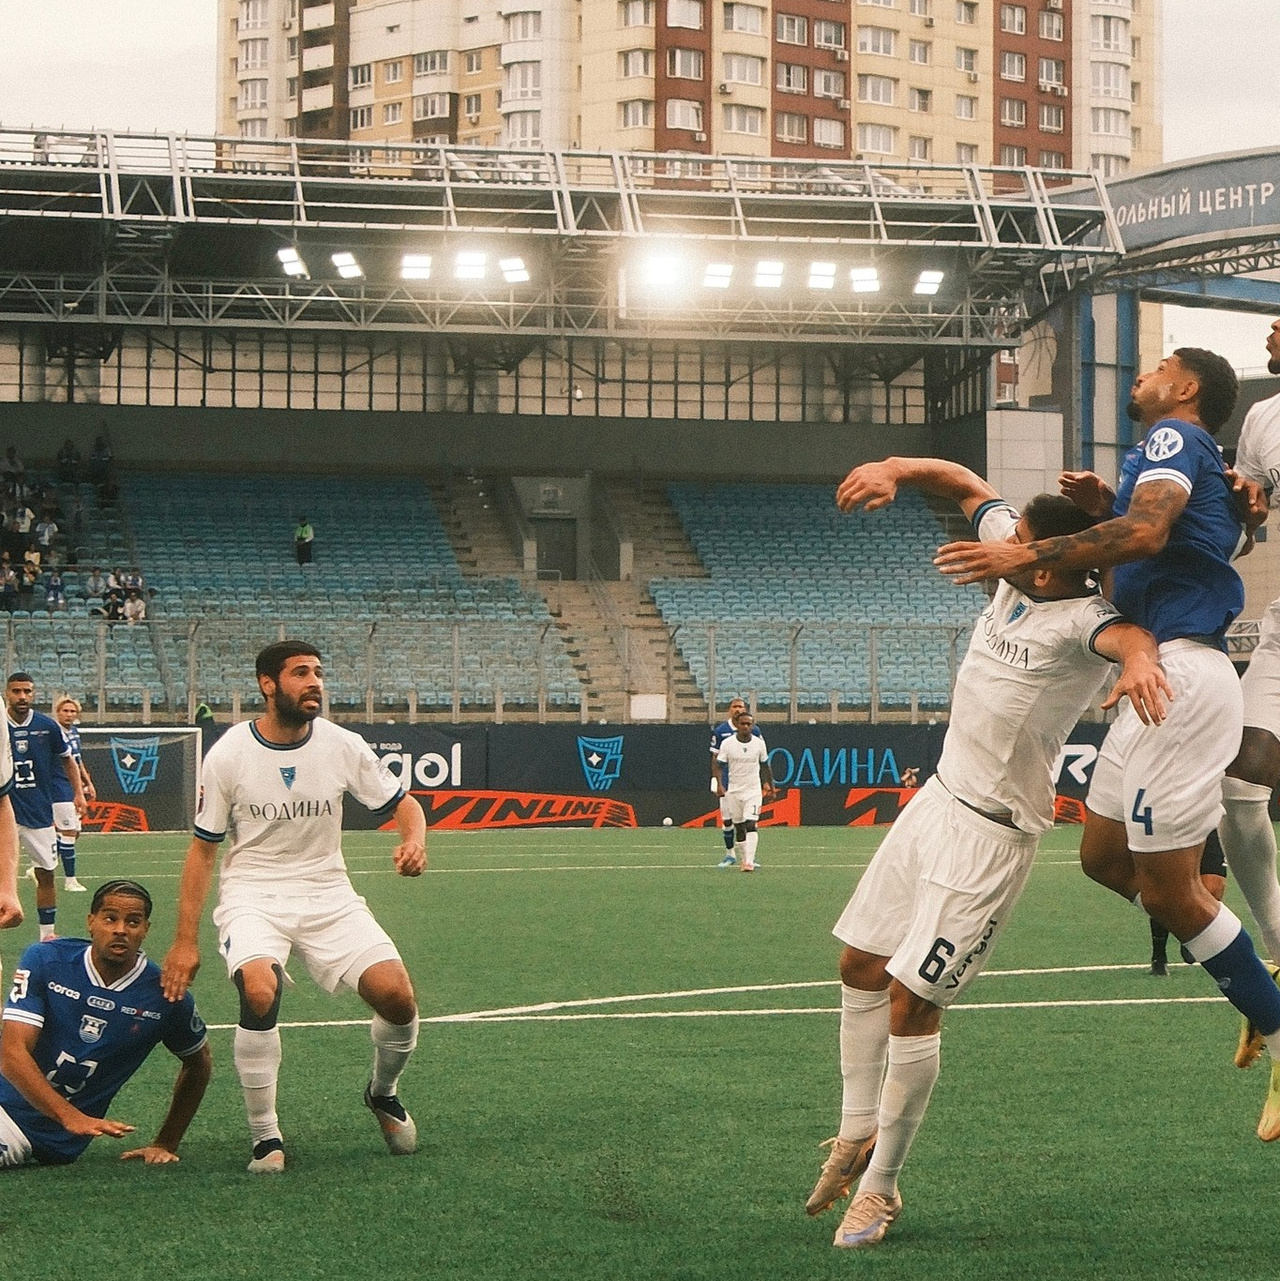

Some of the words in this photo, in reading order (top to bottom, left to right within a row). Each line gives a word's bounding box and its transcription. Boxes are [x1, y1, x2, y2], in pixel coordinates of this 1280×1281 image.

[1112, 187, 1191, 227] ОЛЬНЫЙ
[1199, 182, 1275, 215] ЦЕНТР
[381, 742, 461, 791] gol
[767, 747, 901, 787] ОДИНА
[249, 799, 333, 821] РОДИНА
[1132, 788, 1154, 836] 4
[918, 937, 956, 985] 6
